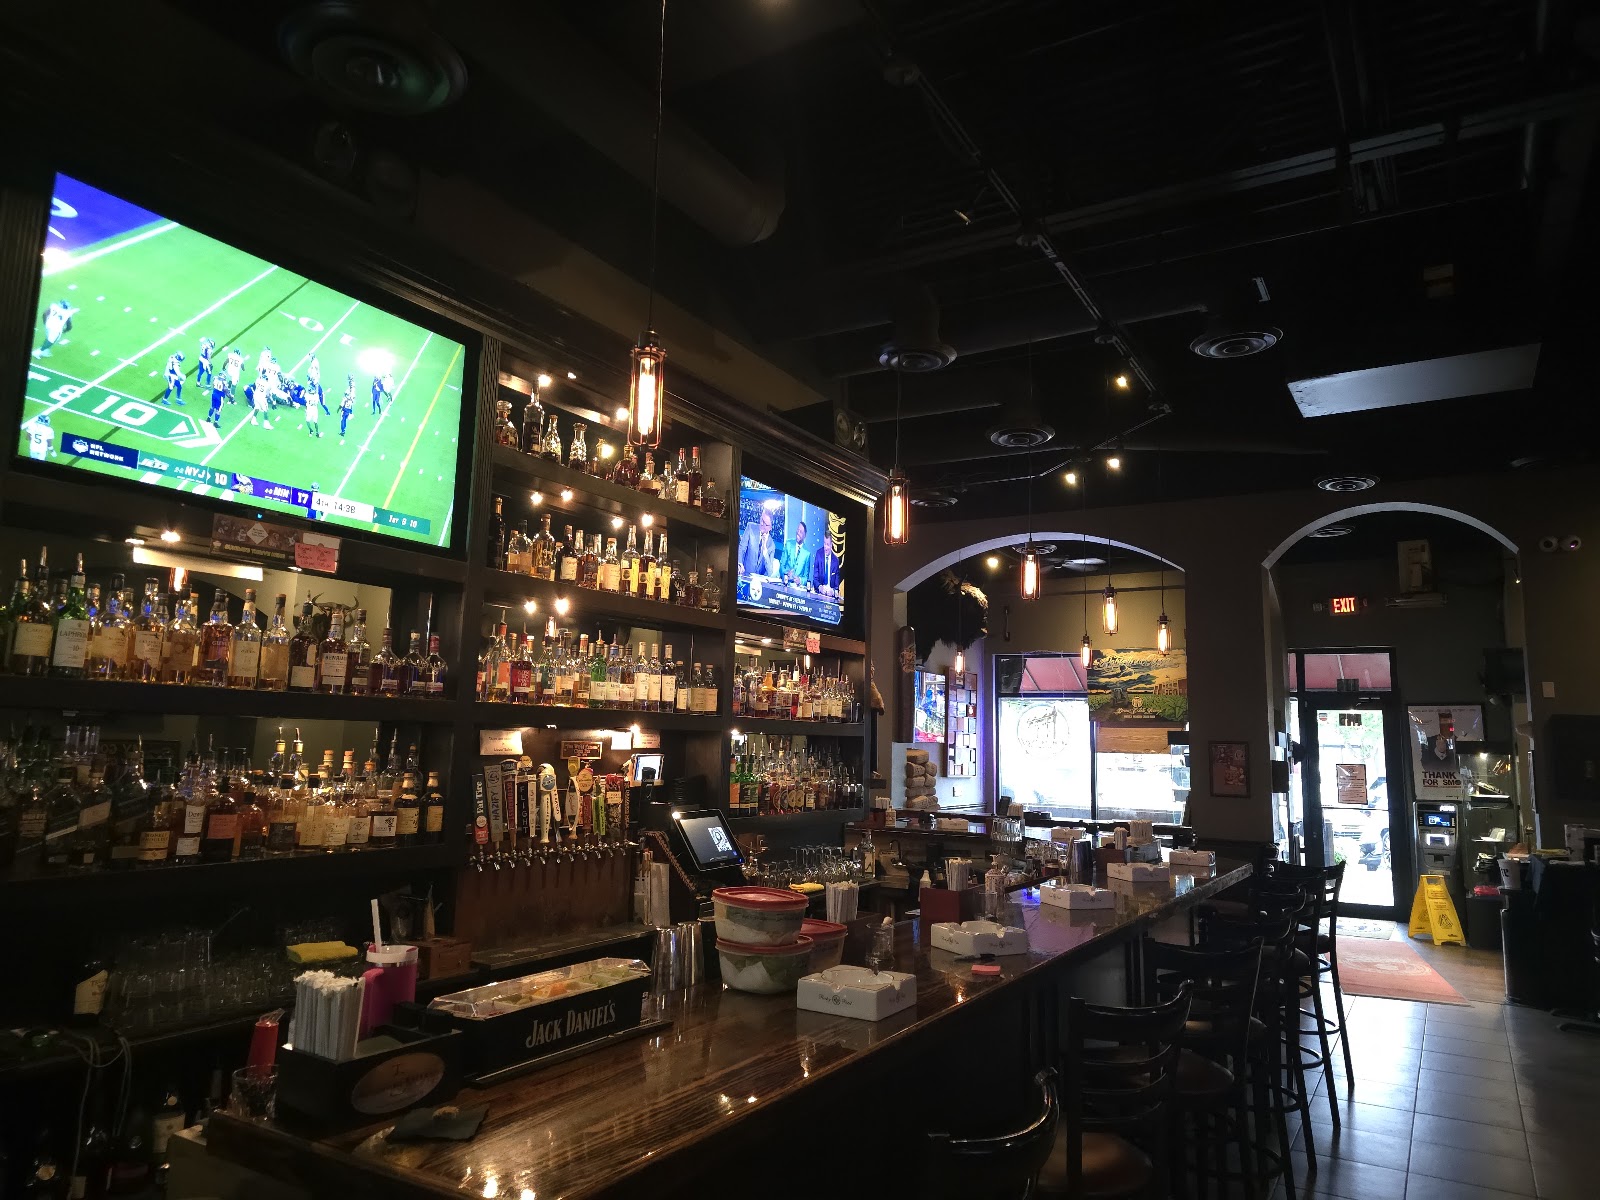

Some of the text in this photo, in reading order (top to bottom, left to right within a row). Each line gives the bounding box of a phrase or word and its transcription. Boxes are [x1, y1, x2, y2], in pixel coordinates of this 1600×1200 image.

[91, 394, 158, 426] 10
[89, 450, 124, 462] NETWORK
[90, 443, 104, 451] NFL
[184, 466, 206, 479] NYJ
[214, 473, 228, 486] 10
[297, 492, 309, 505] 17
[1333, 597, 1355, 613] EXIT
[1422, 771, 1457, 779] THANK
[475, 781, 484, 814] Fat Tire
[491, 791, 500, 821] HAZIFY
[520, 785, 528, 834] FLIGHT
[525, 999, 616, 1049] JACK DANIEL'S
